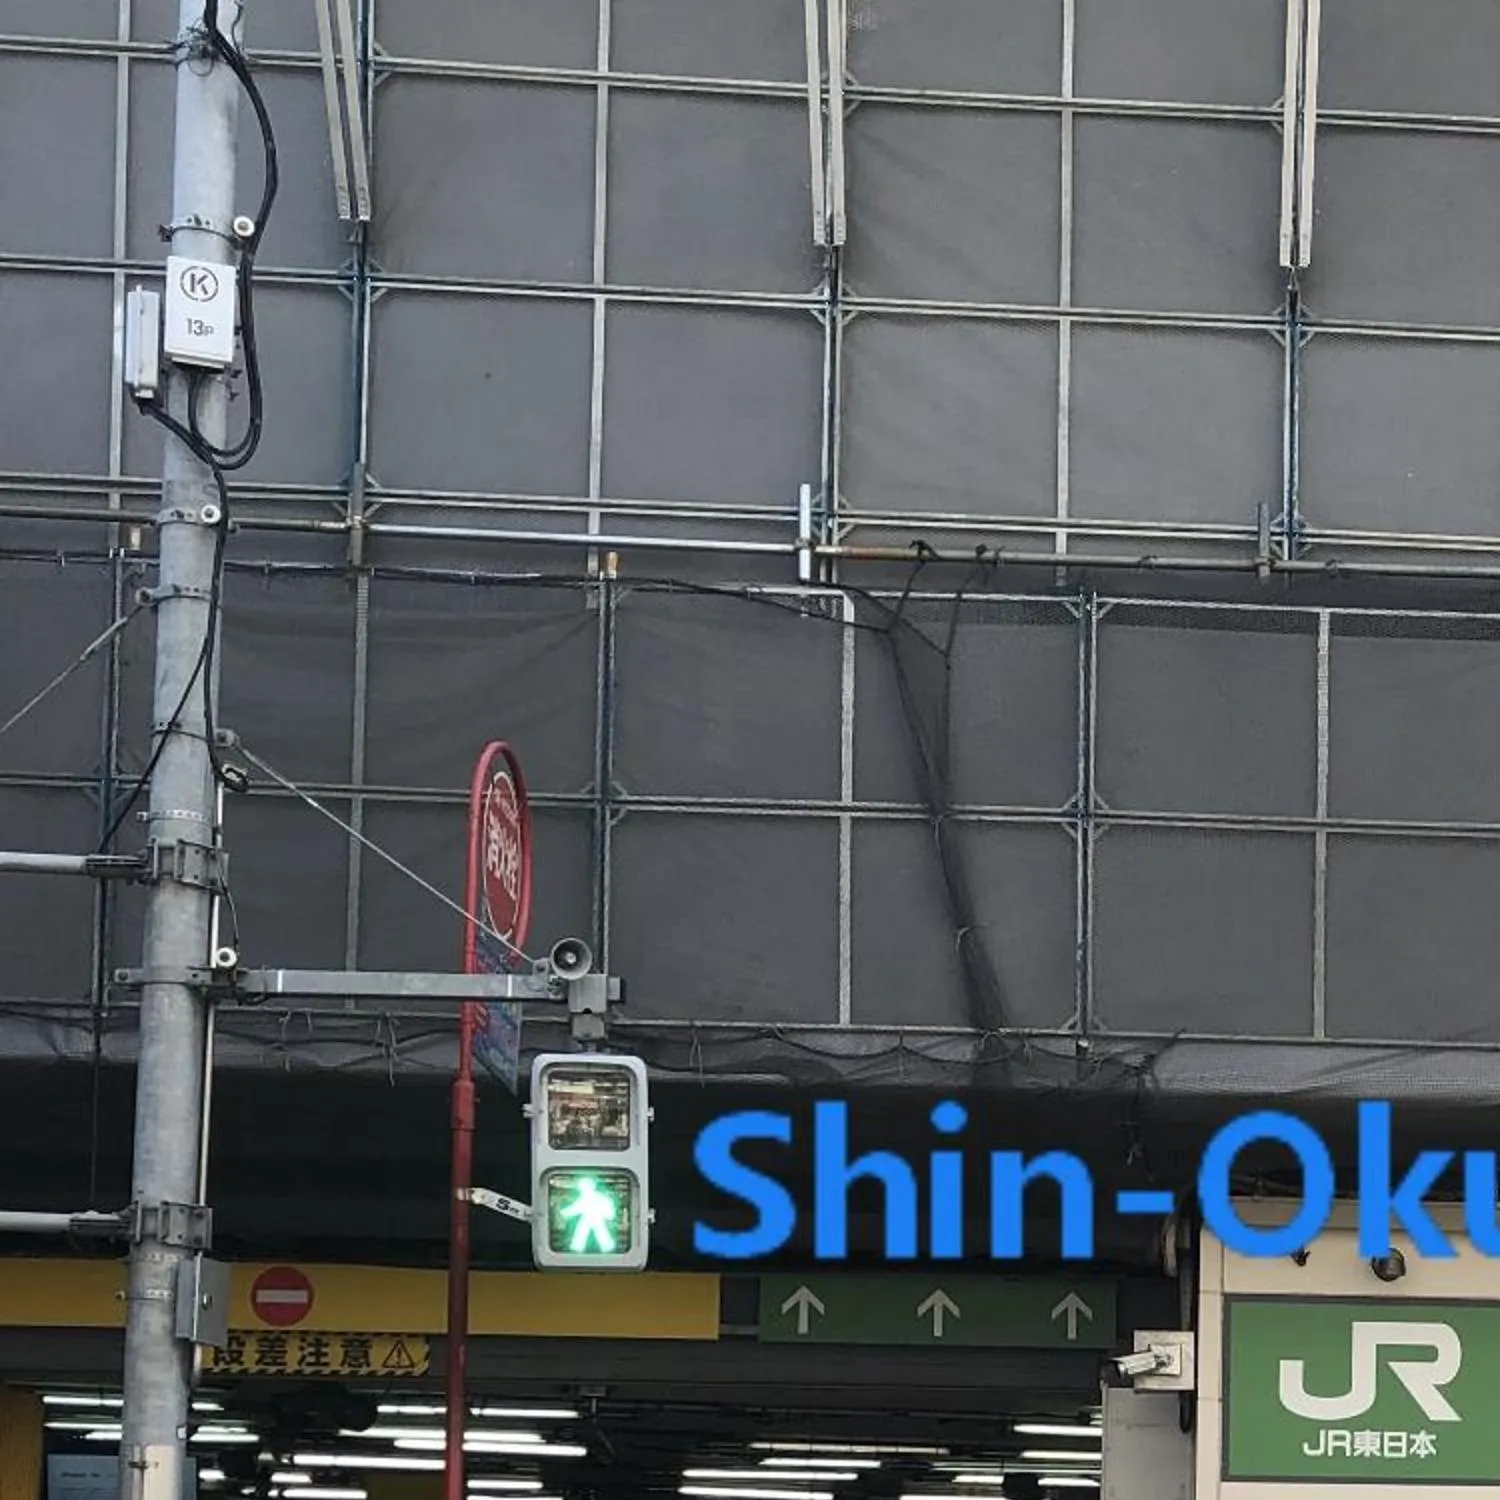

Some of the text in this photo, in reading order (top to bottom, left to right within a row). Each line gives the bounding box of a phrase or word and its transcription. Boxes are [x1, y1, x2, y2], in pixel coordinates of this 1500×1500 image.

[213, 1336, 370, 1367] 段差注意
[1279, 1321, 1462, 1422] JR
[1302, 1428, 1438, 1459] JR東日本
